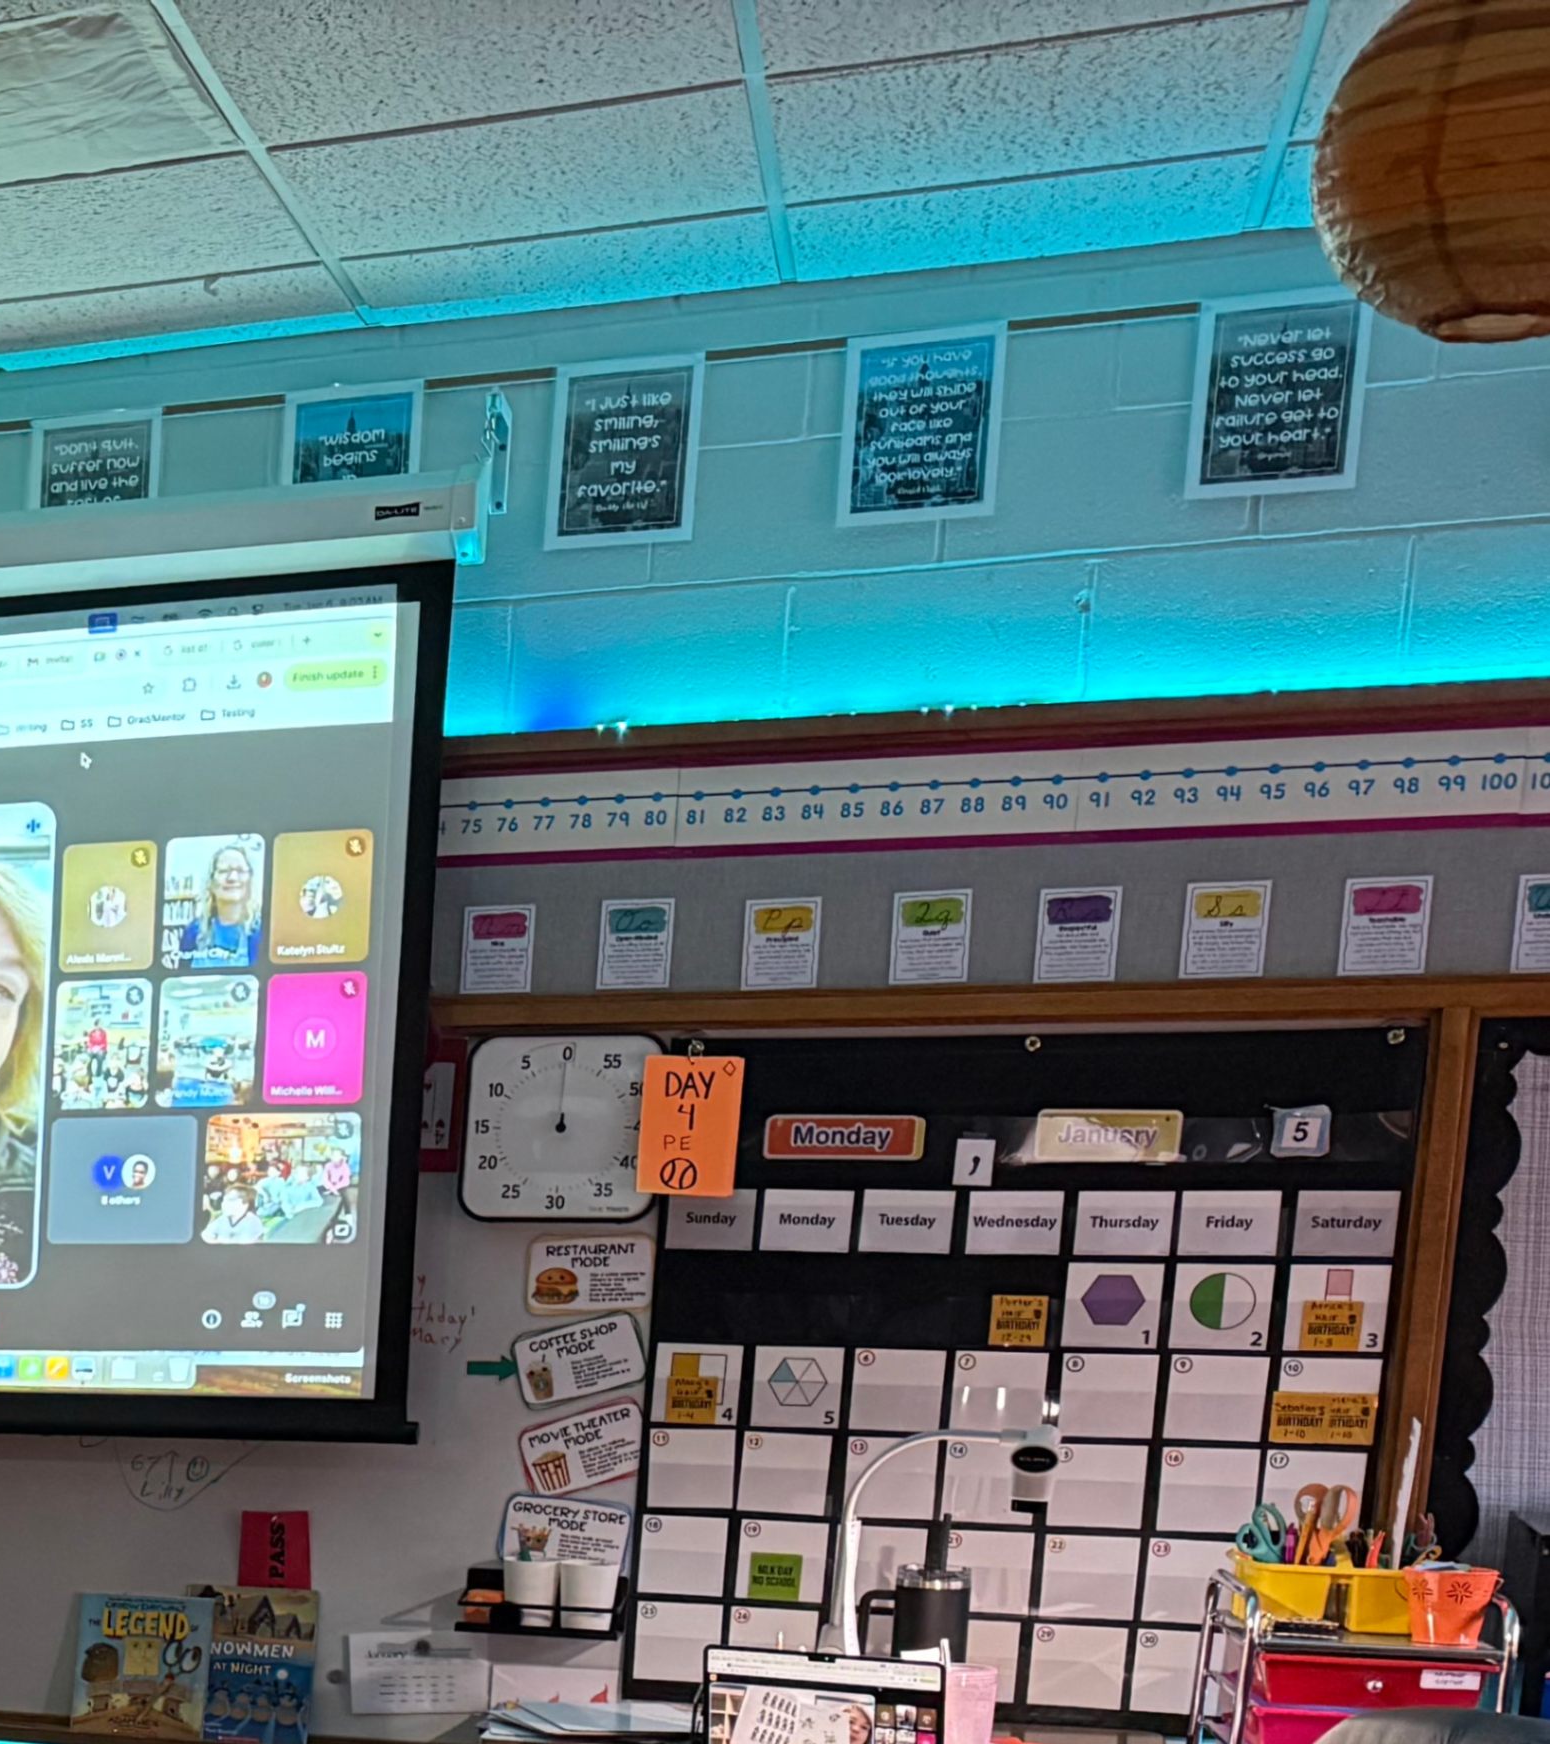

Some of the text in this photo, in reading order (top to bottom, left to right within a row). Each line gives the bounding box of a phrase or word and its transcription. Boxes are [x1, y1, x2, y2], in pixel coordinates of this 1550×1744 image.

[1307, 326, 1332, 341] let
[1230, 347, 1335, 368] success go
[1219, 365, 1343, 388] to your head.
[642, 392, 672, 406] like
[1235, 387, 1323, 407] Never let
[1215, 407, 1339, 428] failure get to
[1219, 432, 1262, 448] your
[51, 455, 140, 475] suffer now
[323, 450, 377, 468] begins
[610, 461, 636, 476] my
[51, 473, 139, 494] and live the
[326, 668, 364, 681] update
[461, 773, 1517, 834] 75 76 77 78 79 80 81 82 83 84 85 86 87 88 89 90 91 92 93 94 95 96 97 98 99 100
[521, 1056, 531, 1069] 5
[563, 1047, 573, 1061] 0
[603, 1054, 622, 1069] 55
[488, 1083, 504, 1098] 10
[665, 1071, 716, 1099] DAY
[677, 1103, 695, 1131] 4
[474, 1119, 490, 1134] 15
[792, 1118, 1309, 1150] Monday January 5
[663, 1134, 691, 1151] PE
[478, 1155, 498, 1170] 20
[501, 1184, 521, 1199] 25
[593, 1183, 613, 1198] 35
[545, 1195, 565, 1210] 30
[685, 1211, 1383, 1231] Sunday Monday Tuesday Wednesday Thursday Friday Saturday
[546, 1243, 636, 1257] RESTAURANT
[571, 1256, 610, 1268] MODE
[529, 1321, 618, 1352] COFFEE SHOP
[1142, 1330, 1378, 1348] 1 2 3
[557, 1340, 595, 1357] MODE
[528, 1407, 631, 1448] MOVIE THEATER
[564, 1430, 603, 1450] MODE
[512, 1501, 626, 1525] GROCERY STORE
[548, 1517, 586, 1532] MODE
[268, 1520, 287, 1579] PASS
[102, 1609, 189, 1640] LEGEND
[210, 1641, 294, 1660] NOWMEN
[230, 1663, 271, 1677] NIGHT
